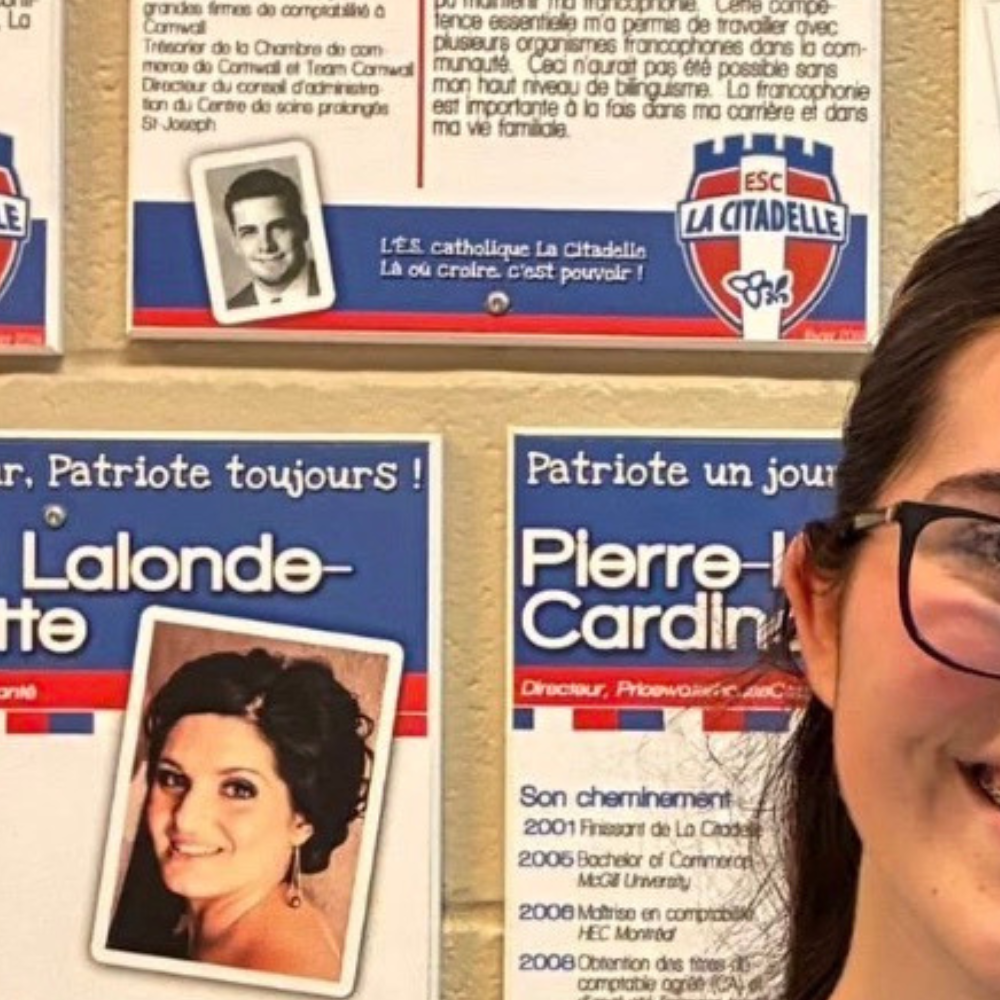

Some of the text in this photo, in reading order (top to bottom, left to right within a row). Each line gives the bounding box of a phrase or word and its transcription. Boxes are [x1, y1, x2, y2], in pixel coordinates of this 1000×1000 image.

[8, 9, 31, 30] La
[432, 77, 471, 94] mon
[477, 74, 517, 95] haut
[523, 75, 581, 96] niveau
[585, 76, 610, 96] de
[727, 78, 750, 99] La
[432, 94, 460, 115] est
[564, 97, 578, 117] à
[583, 97, 599, 117] la
[606, 97, 636, 118] fois
[642, 98, 686, 119] dans
[693, 103, 721, 120] ma
[727, 100, 795, 121] carrière
[800, 101, 818, 121] et
[824, 101, 868, 122] dans
[432, 116, 569, 138] ma vie familiale.
[745, 171, 783, 192] ESC
[685, 199, 841, 236] LA CITADELLE
[536, 239, 558, 257] La
[563, 240, 646, 259] Citadelle
[380, 259, 402, 276] Là
[408, 259, 431, 277] où
[507, 261, 554, 279] c'est
[560, 262, 632, 285] pouvoir
[48, 454, 212, 488] Patriote
[225, 456, 398, 498] toujours
[527, 452, 690, 485] Patriote
[703, 462, 753, 486] un
[22, 530, 354, 593] Lalonde-
[519, 785, 733, 808] Son cheminement
[524, 819, 575, 835] 2001
[650, 820, 671, 837] de
[675, 820, 696, 837] La
